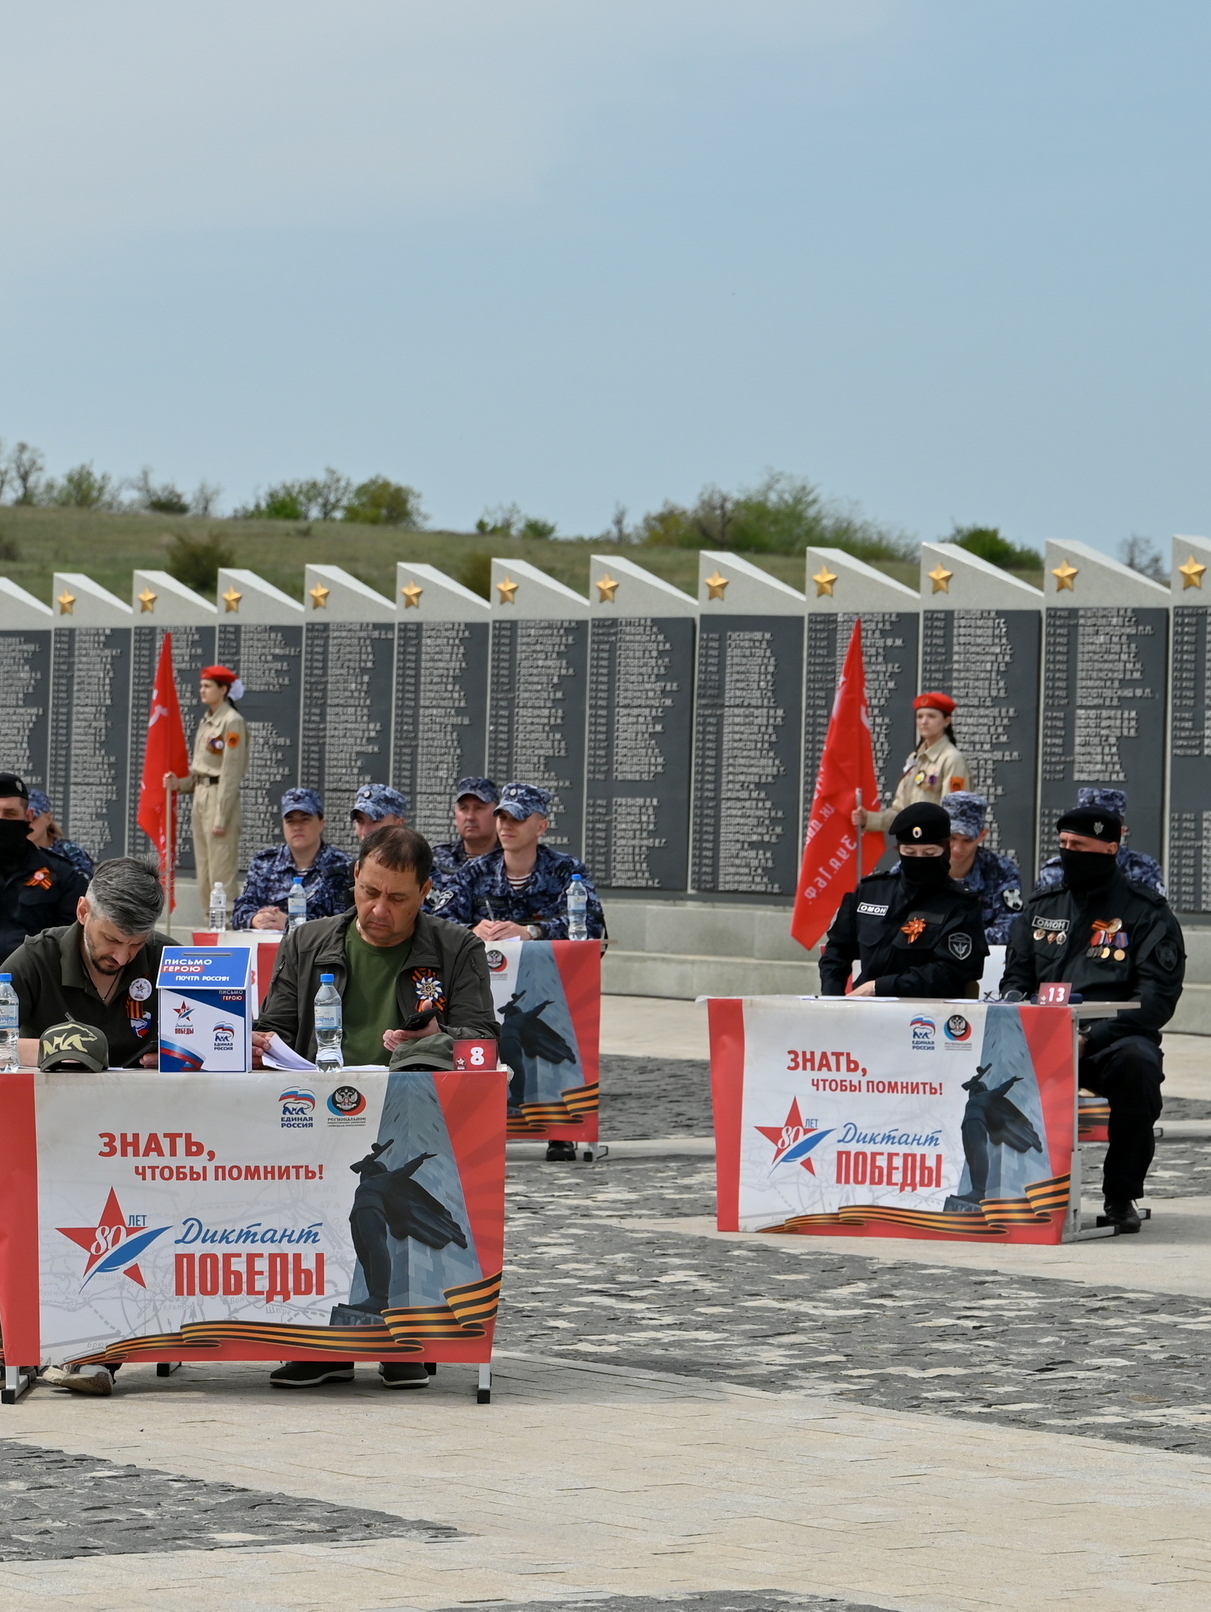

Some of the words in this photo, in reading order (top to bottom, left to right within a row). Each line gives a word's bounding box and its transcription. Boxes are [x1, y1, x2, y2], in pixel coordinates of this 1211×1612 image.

[860, 904, 887, 915] ОМОН
[1035, 918, 1067, 930] ОМОН
[1048, 987, 1065, 1002] 13
[469, 1047, 485, 1066] 8
[787, 1050, 868, 1077] ЗНАТЬ,
[811, 1078, 862, 1092] ЧТОБЫ
[866, 1080, 943, 1095] ПОМНИТЬ!
[778, 1126, 805, 1149] 80
[805, 1118, 819, 1128] ЛЕТ
[837, 1122, 942, 1147] Диктант
[98, 1132, 216, 1162] ЗНАТЬ,
[134, 1166, 207, 1181] ЧТОБЫ
[214, 1164, 325, 1181] ПОМНИТЬ!
[836, 1151, 943, 1193] ПОБЕДЫ
[90, 1224, 127, 1256] 80
[128, 1215, 147, 1227] ЛЕТ
[174, 1217, 323, 1245] Диктант
[174, 1252, 325, 1304] ПОБЕДЫ
